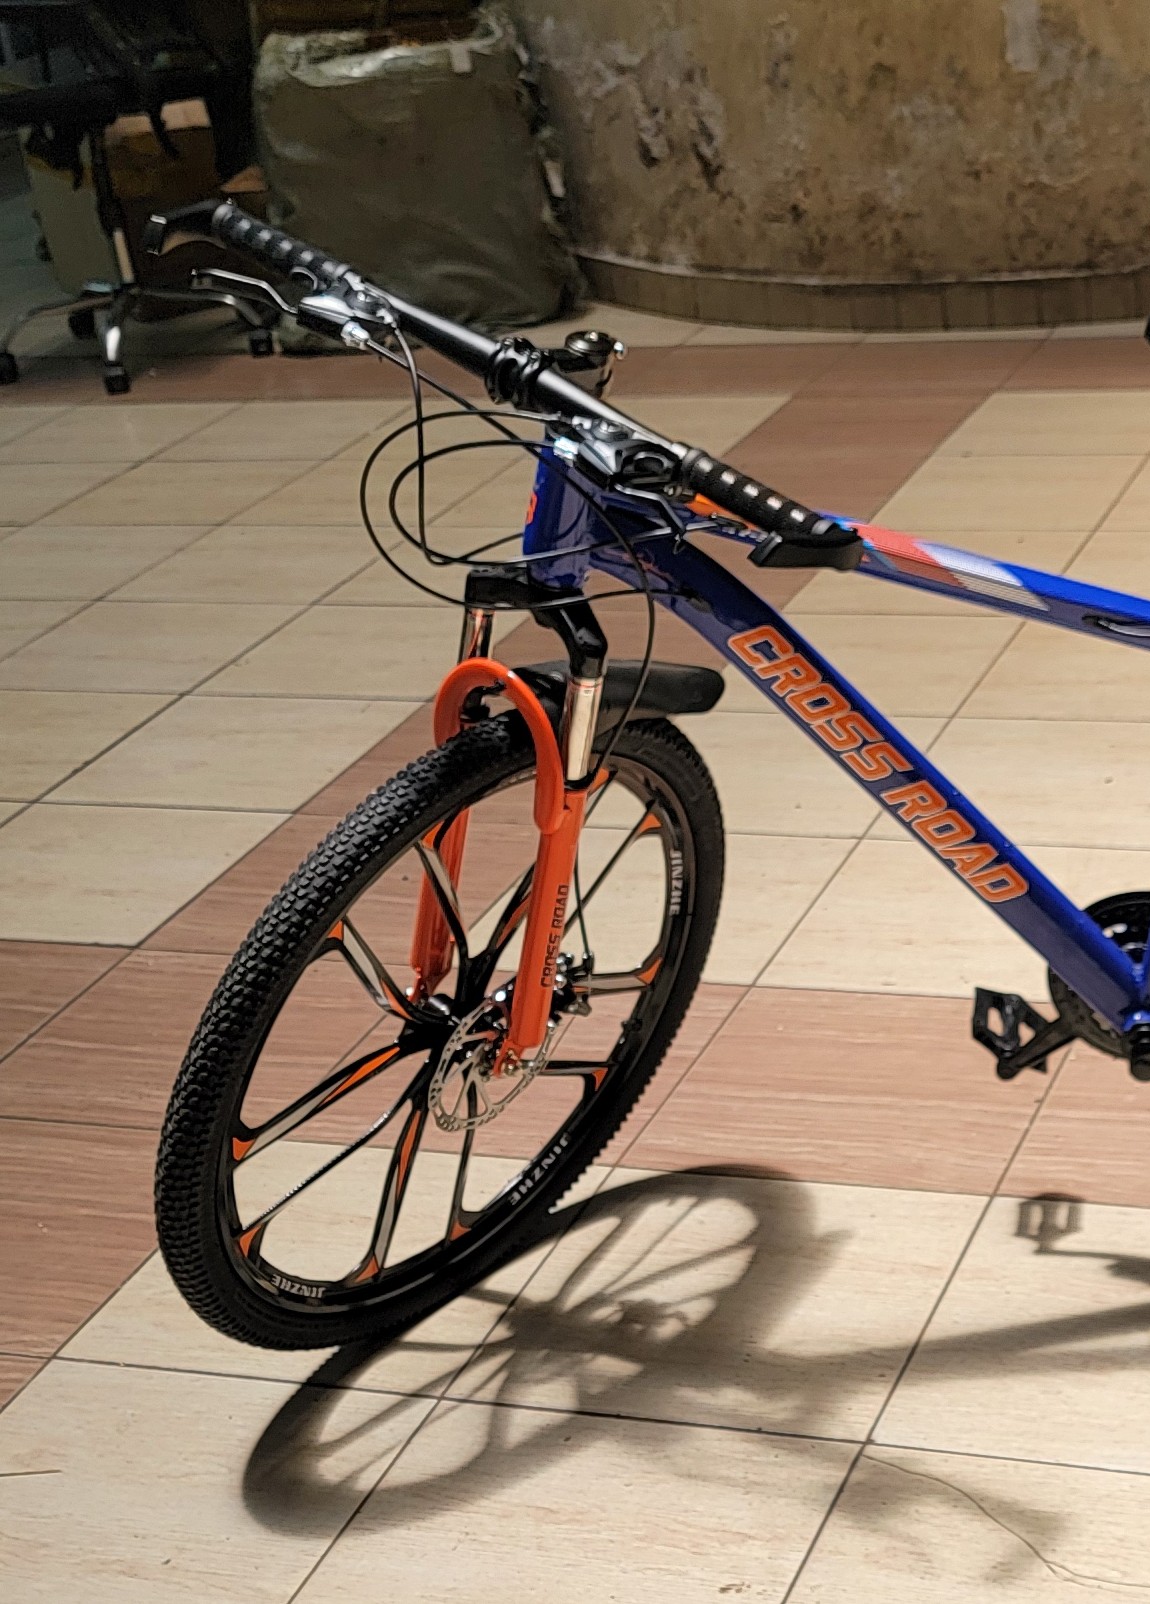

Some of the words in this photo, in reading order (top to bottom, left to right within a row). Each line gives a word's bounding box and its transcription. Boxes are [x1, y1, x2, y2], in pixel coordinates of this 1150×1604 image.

[728, 625, 914, 782] CROSS
[880, 780, 1029, 903] ROAD
[669, 848, 683, 916] JINZHE
[541, 931, 561, 988] CROSS
[551, 884, 570, 930] ROAD
[508, 1132, 569, 1206] JINZHE
[270, 1273, 326, 1298] JINZHE
